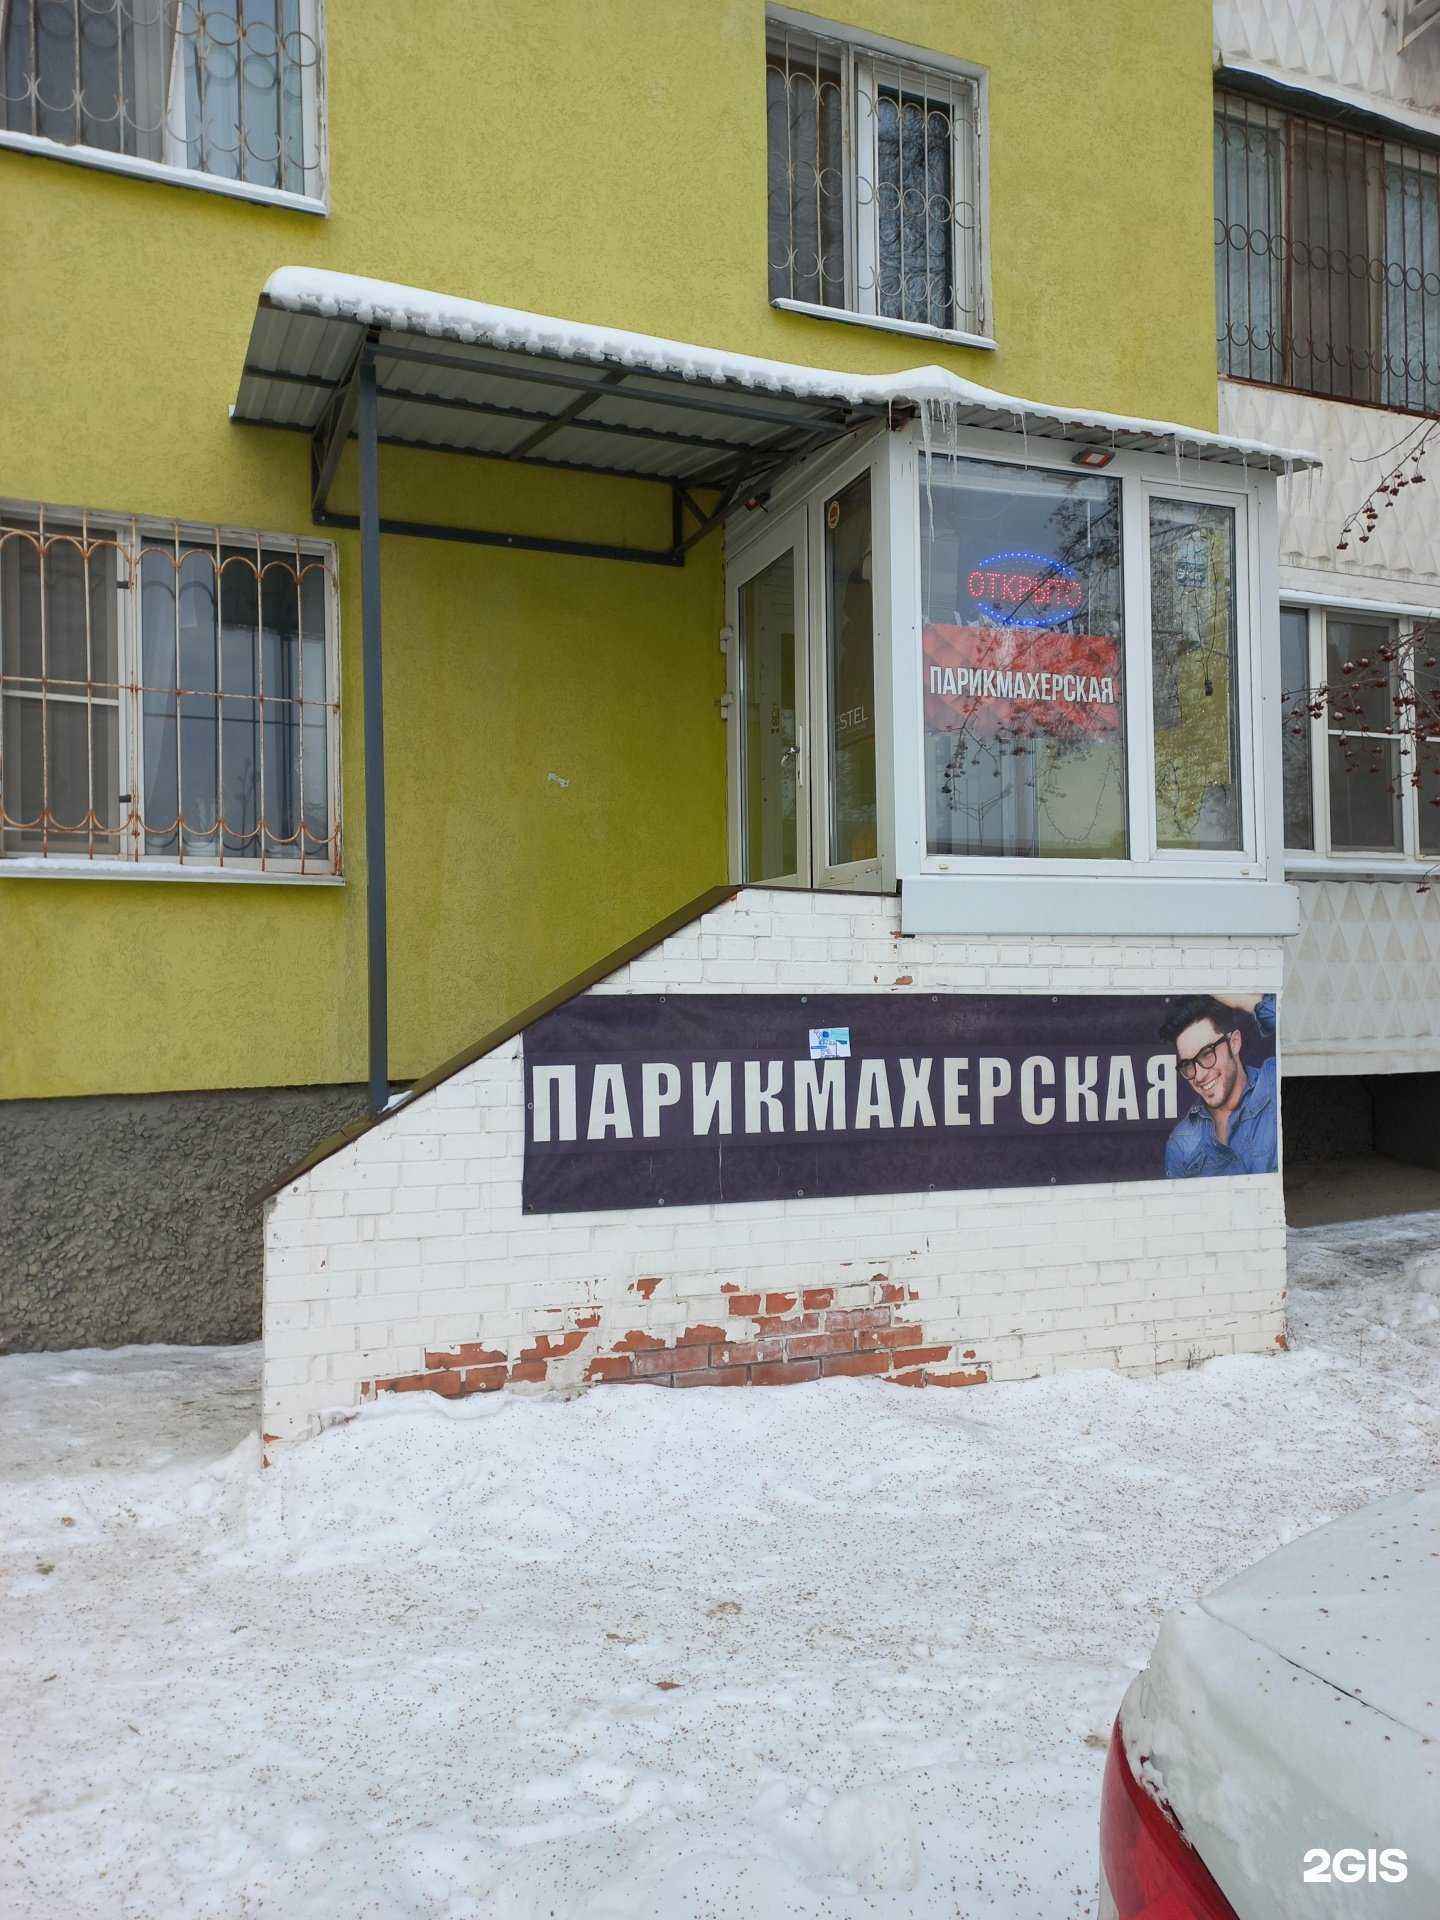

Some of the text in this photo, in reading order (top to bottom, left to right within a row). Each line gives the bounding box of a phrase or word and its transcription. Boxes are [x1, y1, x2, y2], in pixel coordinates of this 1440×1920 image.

[968, 571, 1083, 609] ОТКРЫТО
[930, 665, 1114, 704] ПАРИКМАХЕРСКАЯ
[837, 704, 869, 730] STEL
[532, 1054, 1178, 1142] ПАРИКМАХЕРСКАЯ
